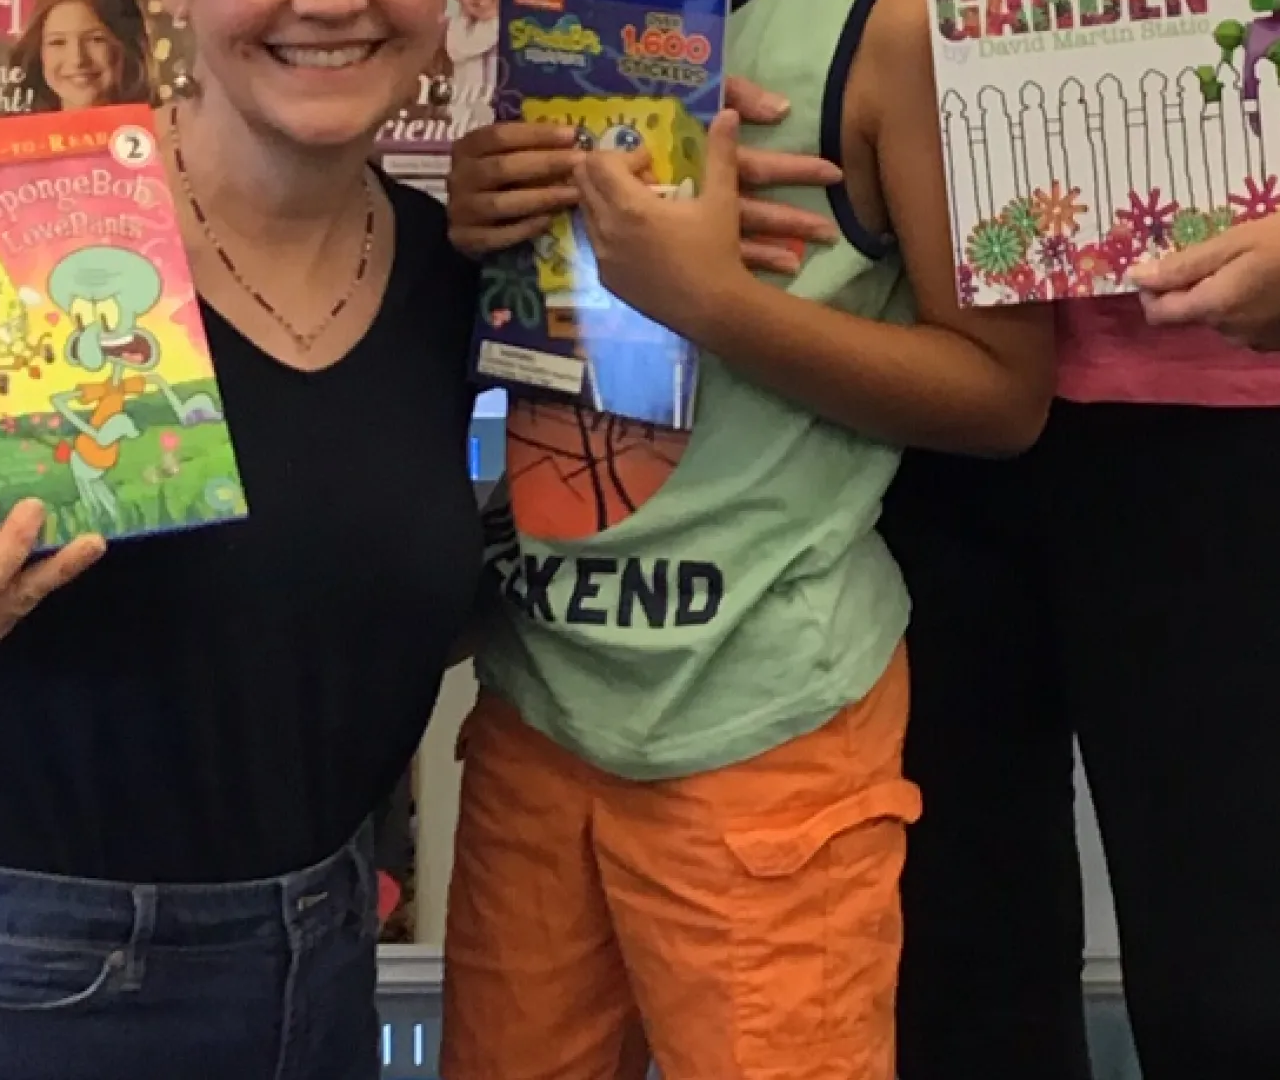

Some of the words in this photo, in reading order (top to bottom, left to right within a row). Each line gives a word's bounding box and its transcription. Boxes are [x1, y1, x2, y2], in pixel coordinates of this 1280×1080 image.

[942, 41, 970, 65] by
[978, 33, 1046, 58] David
[1052, 25, 1135, 51] Martin
[617, 57, 709, 87] STICKERS
[125, 135, 145, 159] 2
[1, 211, 144, 253] LovePants
